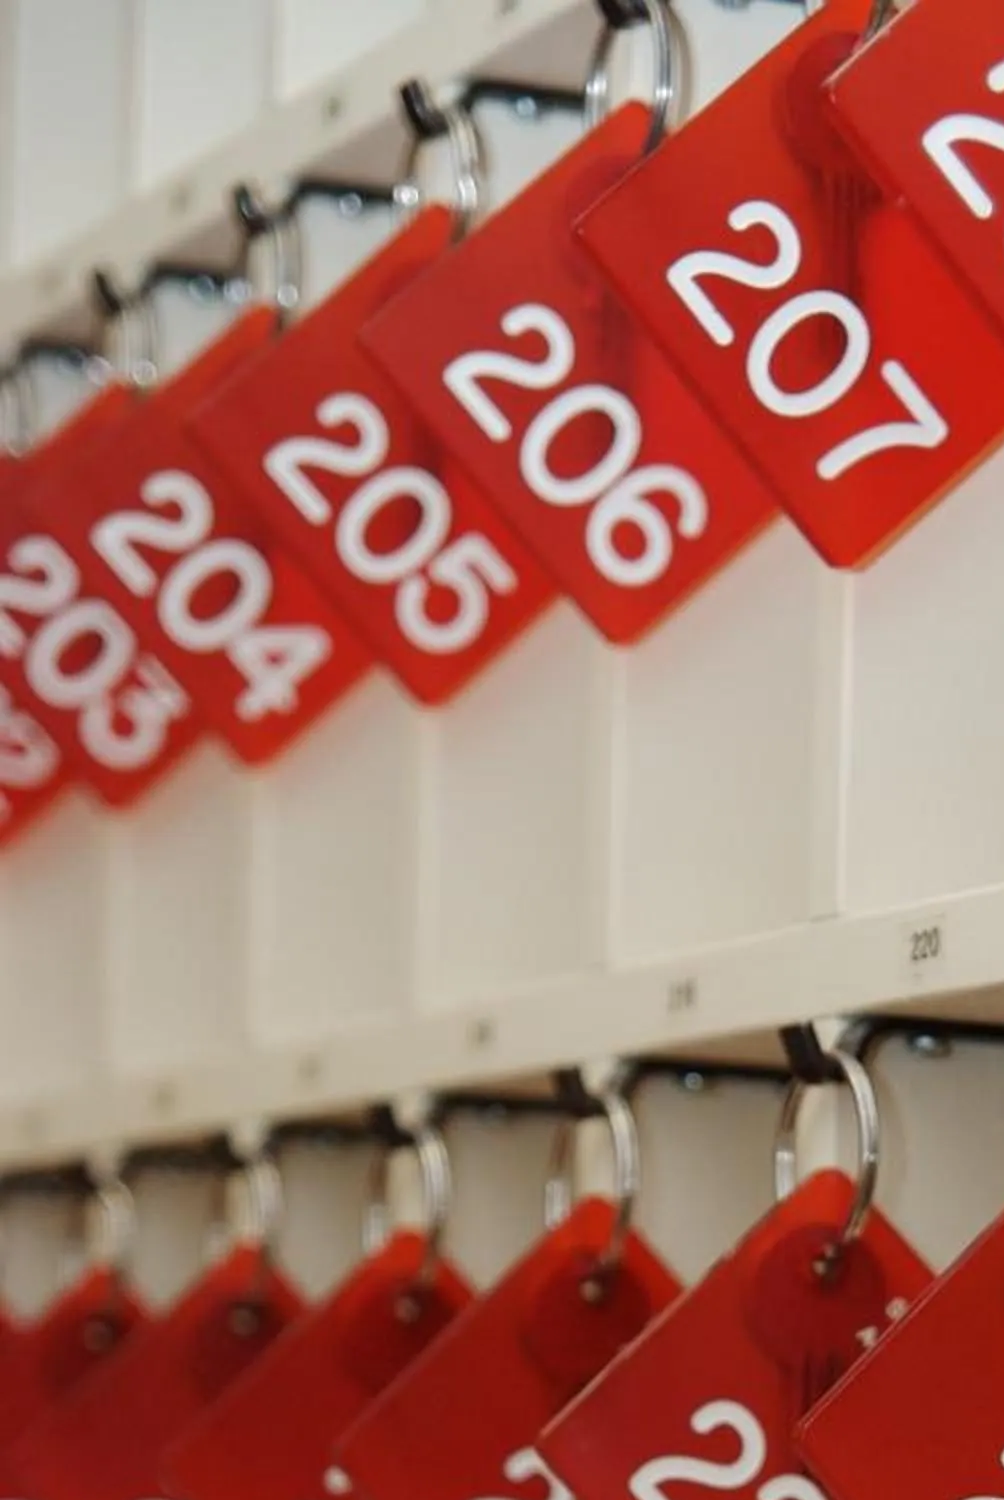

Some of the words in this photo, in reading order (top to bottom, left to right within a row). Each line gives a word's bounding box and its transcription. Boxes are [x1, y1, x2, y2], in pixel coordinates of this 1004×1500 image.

[443, 303, 708, 586] 206
[666, 200, 948, 482] 207
[0, 534, 190, 769] 203
[90, 469, 331, 721] 204
[263, 392, 518, 654] 205
[910, 926, 941, 961] 220
